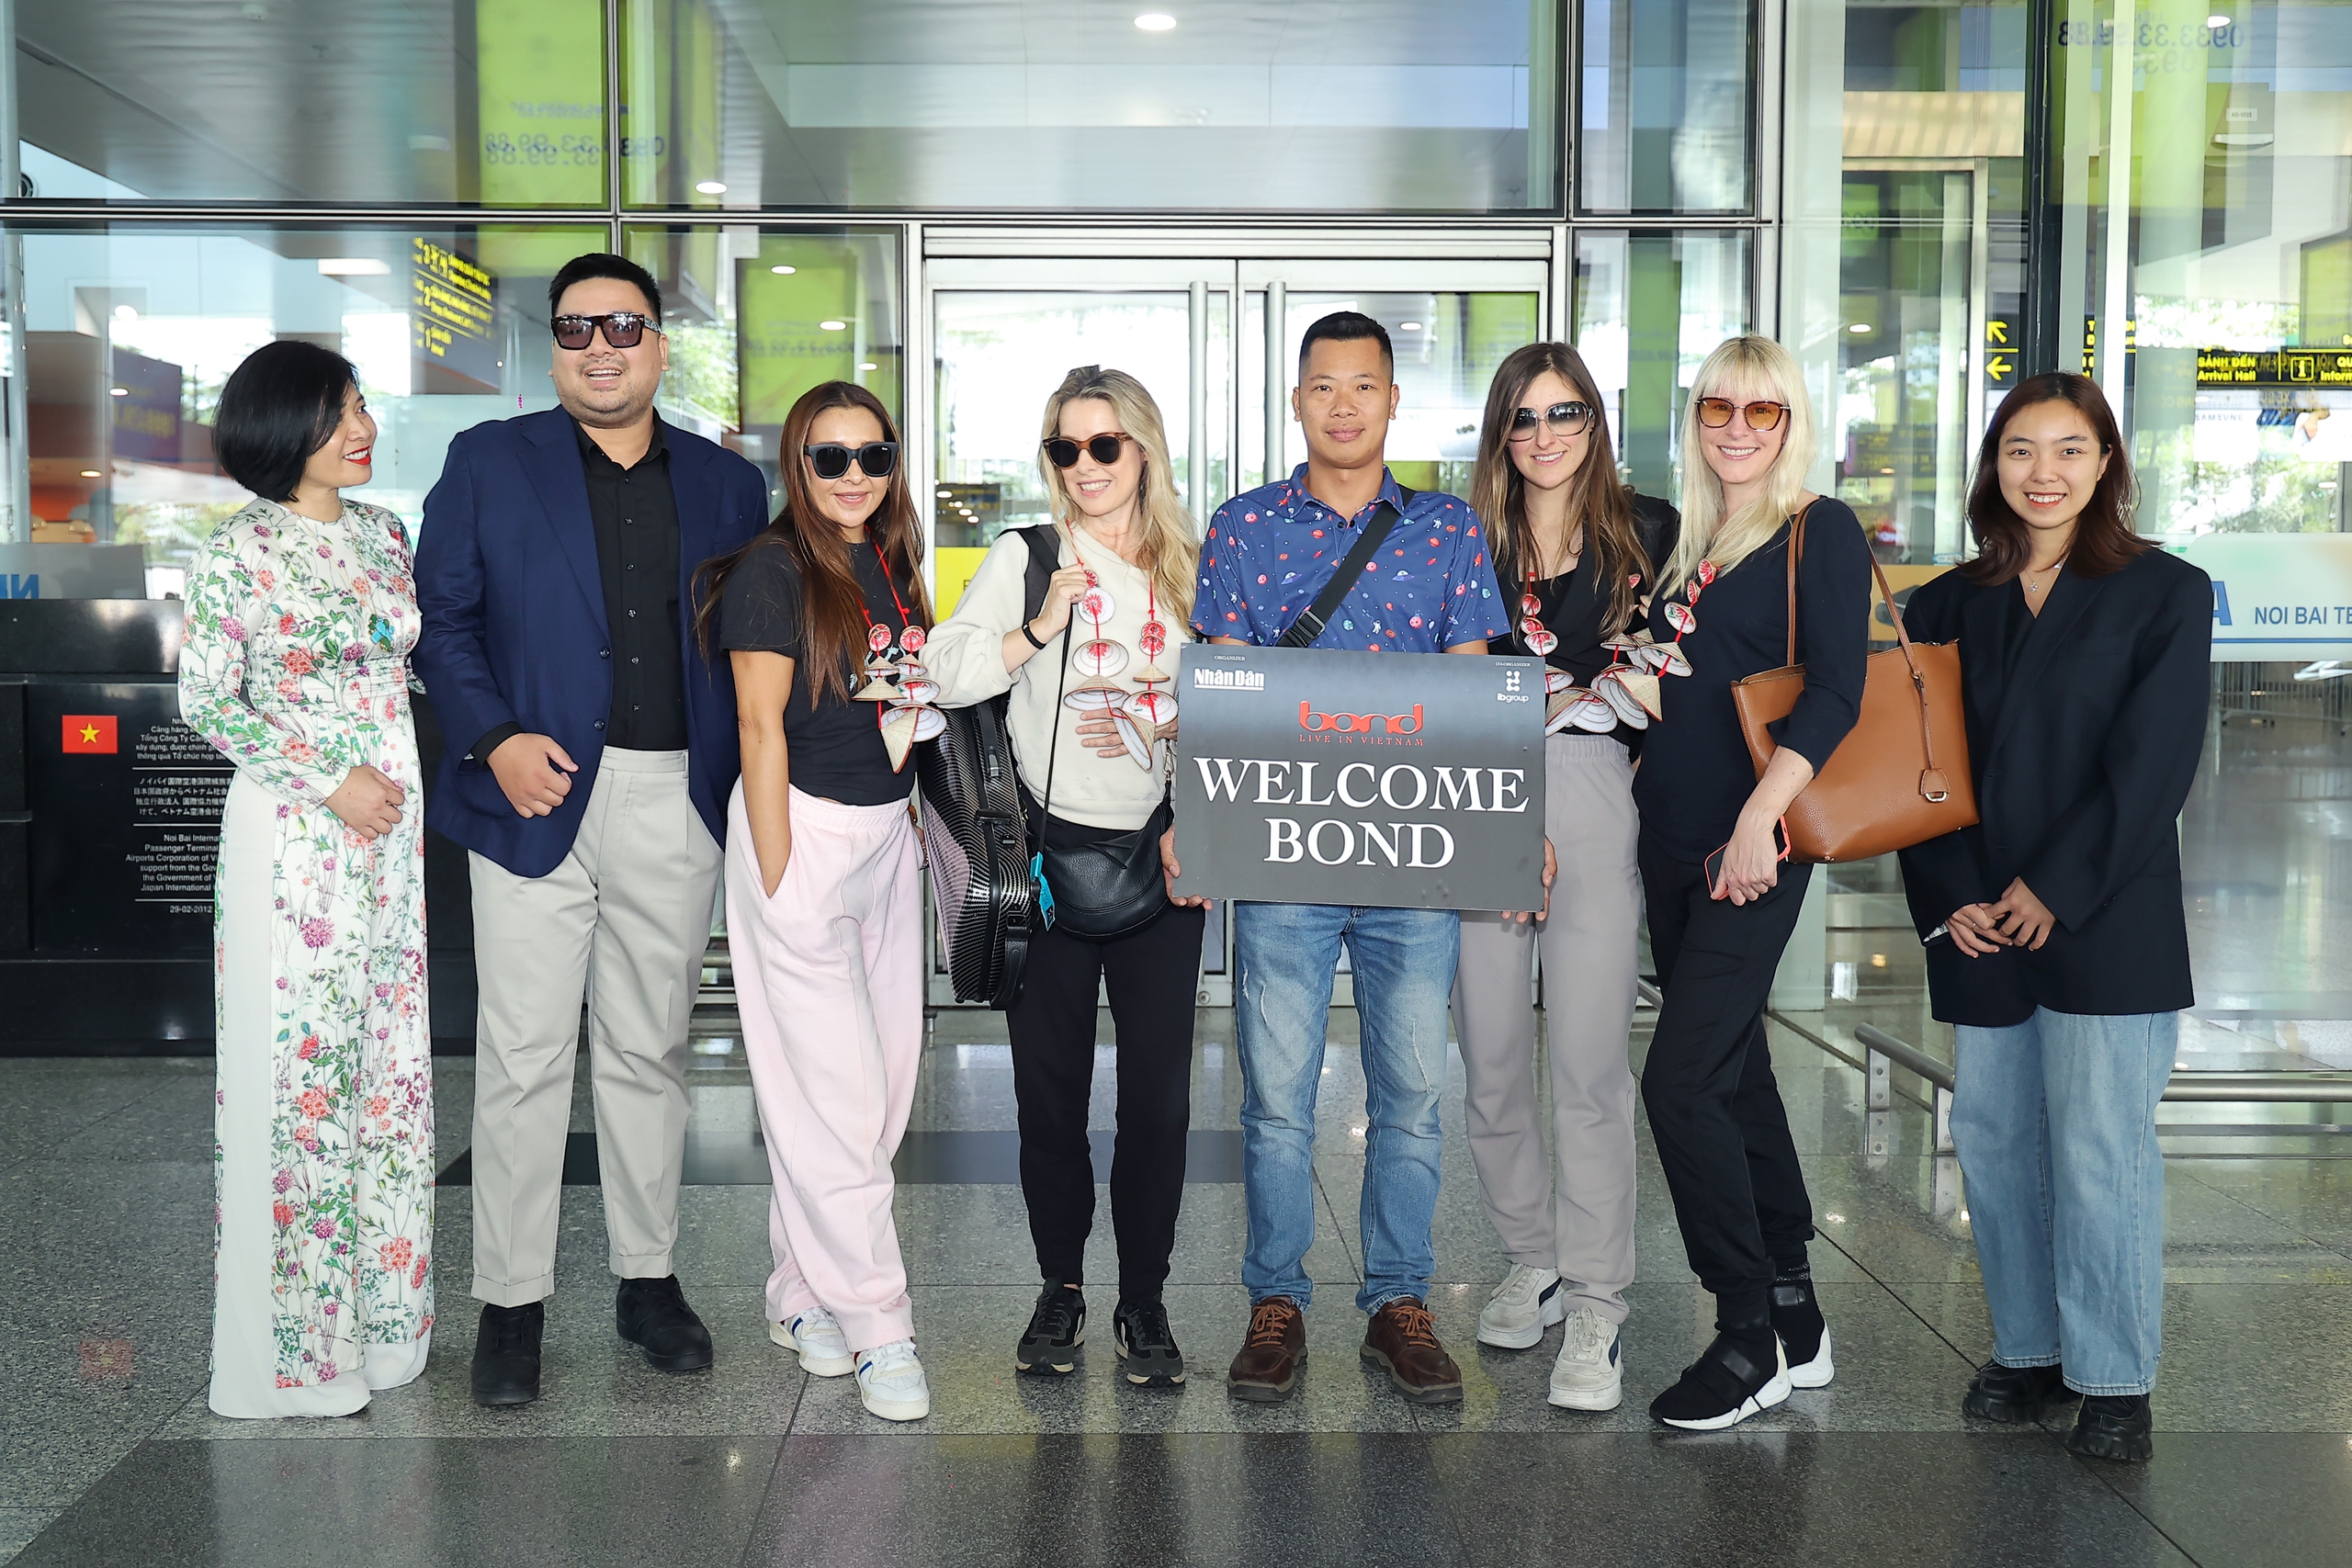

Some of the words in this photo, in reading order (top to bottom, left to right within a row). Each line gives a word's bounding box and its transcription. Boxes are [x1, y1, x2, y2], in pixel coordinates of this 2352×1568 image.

[2198, 370, 2233, 381] Arrival
[2235, 370, 2256, 381] Hall
[2255, 606, 2288, 626] NOI
[2295, 606, 2327, 625] BAI
[1194, 668, 1234, 686] Nhân
[1235, 670, 1264, 687] Dân
[1497, 693, 1530, 704] ibgroup
[1298, 700, 1424, 736] bond
[1299, 734, 1331, 743] LIVE
[1339, 736, 1353, 744] IN
[1361, 737, 1424, 747] VIETNAM
[1193, 756, 1531, 814] WELCOME
[145, 844, 185, 853] Passenger
[187, 844, 219, 852] Terminal
[1262, 817, 1456, 869] BOND
[126, 854, 154, 863] Airports
[156, 854, 199, 863] Corporation
[140, 864, 168, 873] support
[169, 863, 187, 872] from
[142, 874, 154, 882] the
[156, 874, 203, 882] Government
[141, 884, 164, 892] Japan
[170, 905, 213, 914] 29-02-2012
